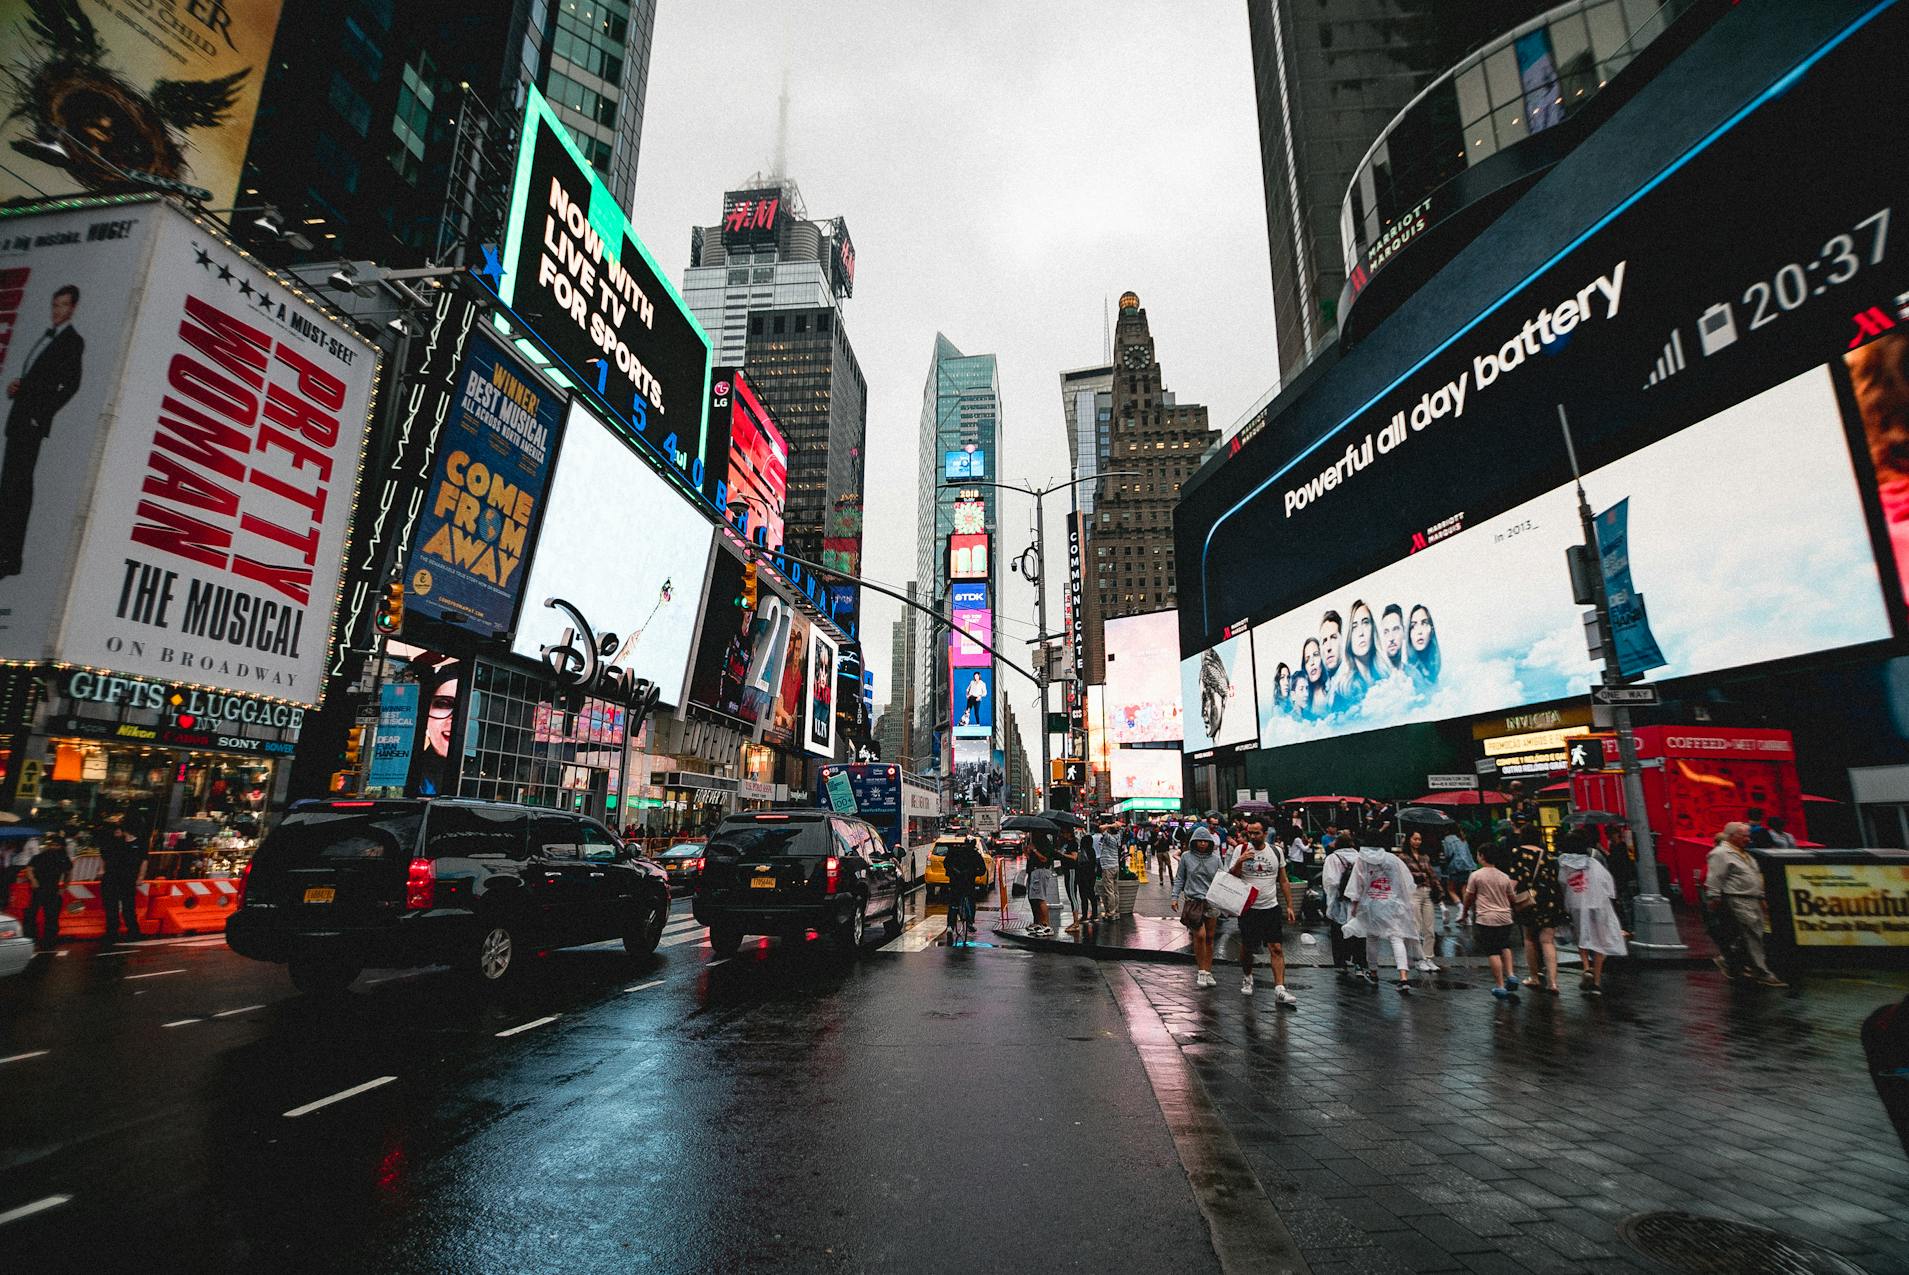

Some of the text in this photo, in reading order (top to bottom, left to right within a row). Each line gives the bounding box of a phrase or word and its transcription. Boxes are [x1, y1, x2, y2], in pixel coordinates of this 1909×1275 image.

[724, 198, 779, 233] H&M
[1368, 196, 1432, 260] MARRIOTT
[1369, 218, 1425, 273] MARQUIS
[544, 214, 627, 328] LIVE TV
[550, 176, 655, 330] NOW WITH
[1742, 206, 1893, 334] 20:37
[276, 302, 354, 367] A MUST-SEE!
[539, 252, 666, 415] FOR SPORTS.
[465, 369, 501, 414] BEST
[499, 395, 548, 453] MUSICAL
[492, 362, 540, 419] WINNER!
[714, 398, 728, 408] LG
[1284, 260, 1627, 519] Powerful all day battery
[130, 293, 273, 571] WOMAN
[461, 395, 475, 414] ALL
[475, 405, 502, 433] ACROSS
[501, 425, 521, 447] NORTH
[520, 438, 545, 465] AMERICA
[231, 340, 347, 607] PRETTY
[445, 450, 535, 524] COME
[422, 523, 520, 589] AWAY
[115, 558, 304, 660] THE MUSICAL
[962, 592, 984, 601] TDK
[1070, 531, 1083, 669] COMMUNICATE
[106, 636, 299, 688] ON BROADWAY
[542, 597, 661, 737] Disney
[745, 595, 794, 698] 21
[68, 671, 305, 730] GIFTS LUGGAGE
[194, 715, 223, 733] NY
[1506, 709, 1561, 731] INVICTA
[1600, 687, 1650, 700] ONE WAY
[115, 725, 156, 740] Nikon
[217, 736, 260, 751] SONY
[264, 741, 295, 754] BOWER
[375, 749, 409, 758] HANSEN
[376, 735, 400, 744] DEAR
[1666, 736, 1728, 750] COFFEED
[20, 761, 37, 795] ATM
